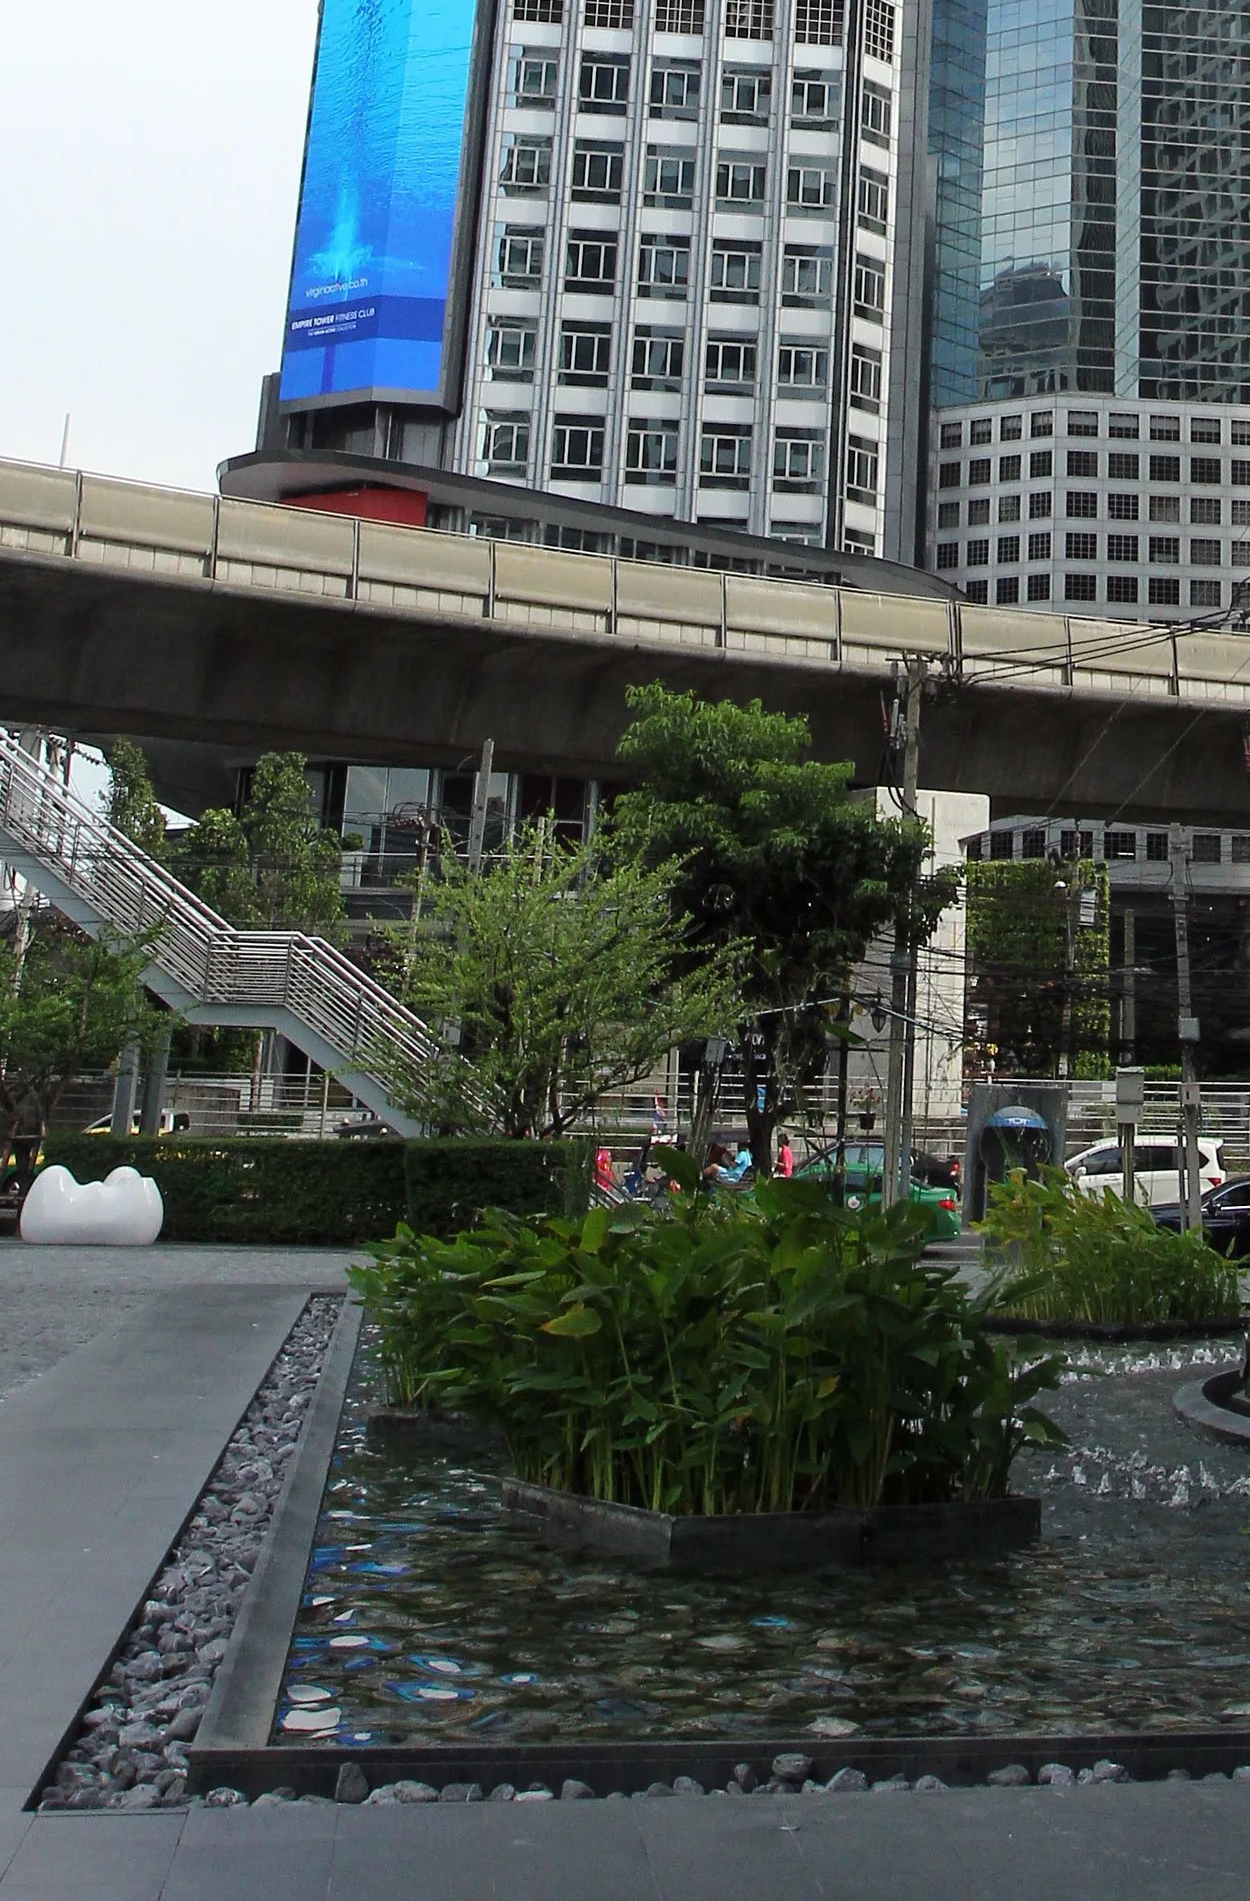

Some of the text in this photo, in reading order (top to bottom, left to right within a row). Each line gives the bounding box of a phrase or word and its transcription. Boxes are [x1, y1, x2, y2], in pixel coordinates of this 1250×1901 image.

[291, 307, 375, 330] EMPIRE TOWER FITNESS CLUB
[1004, 1117, 1031, 1126] TOT
